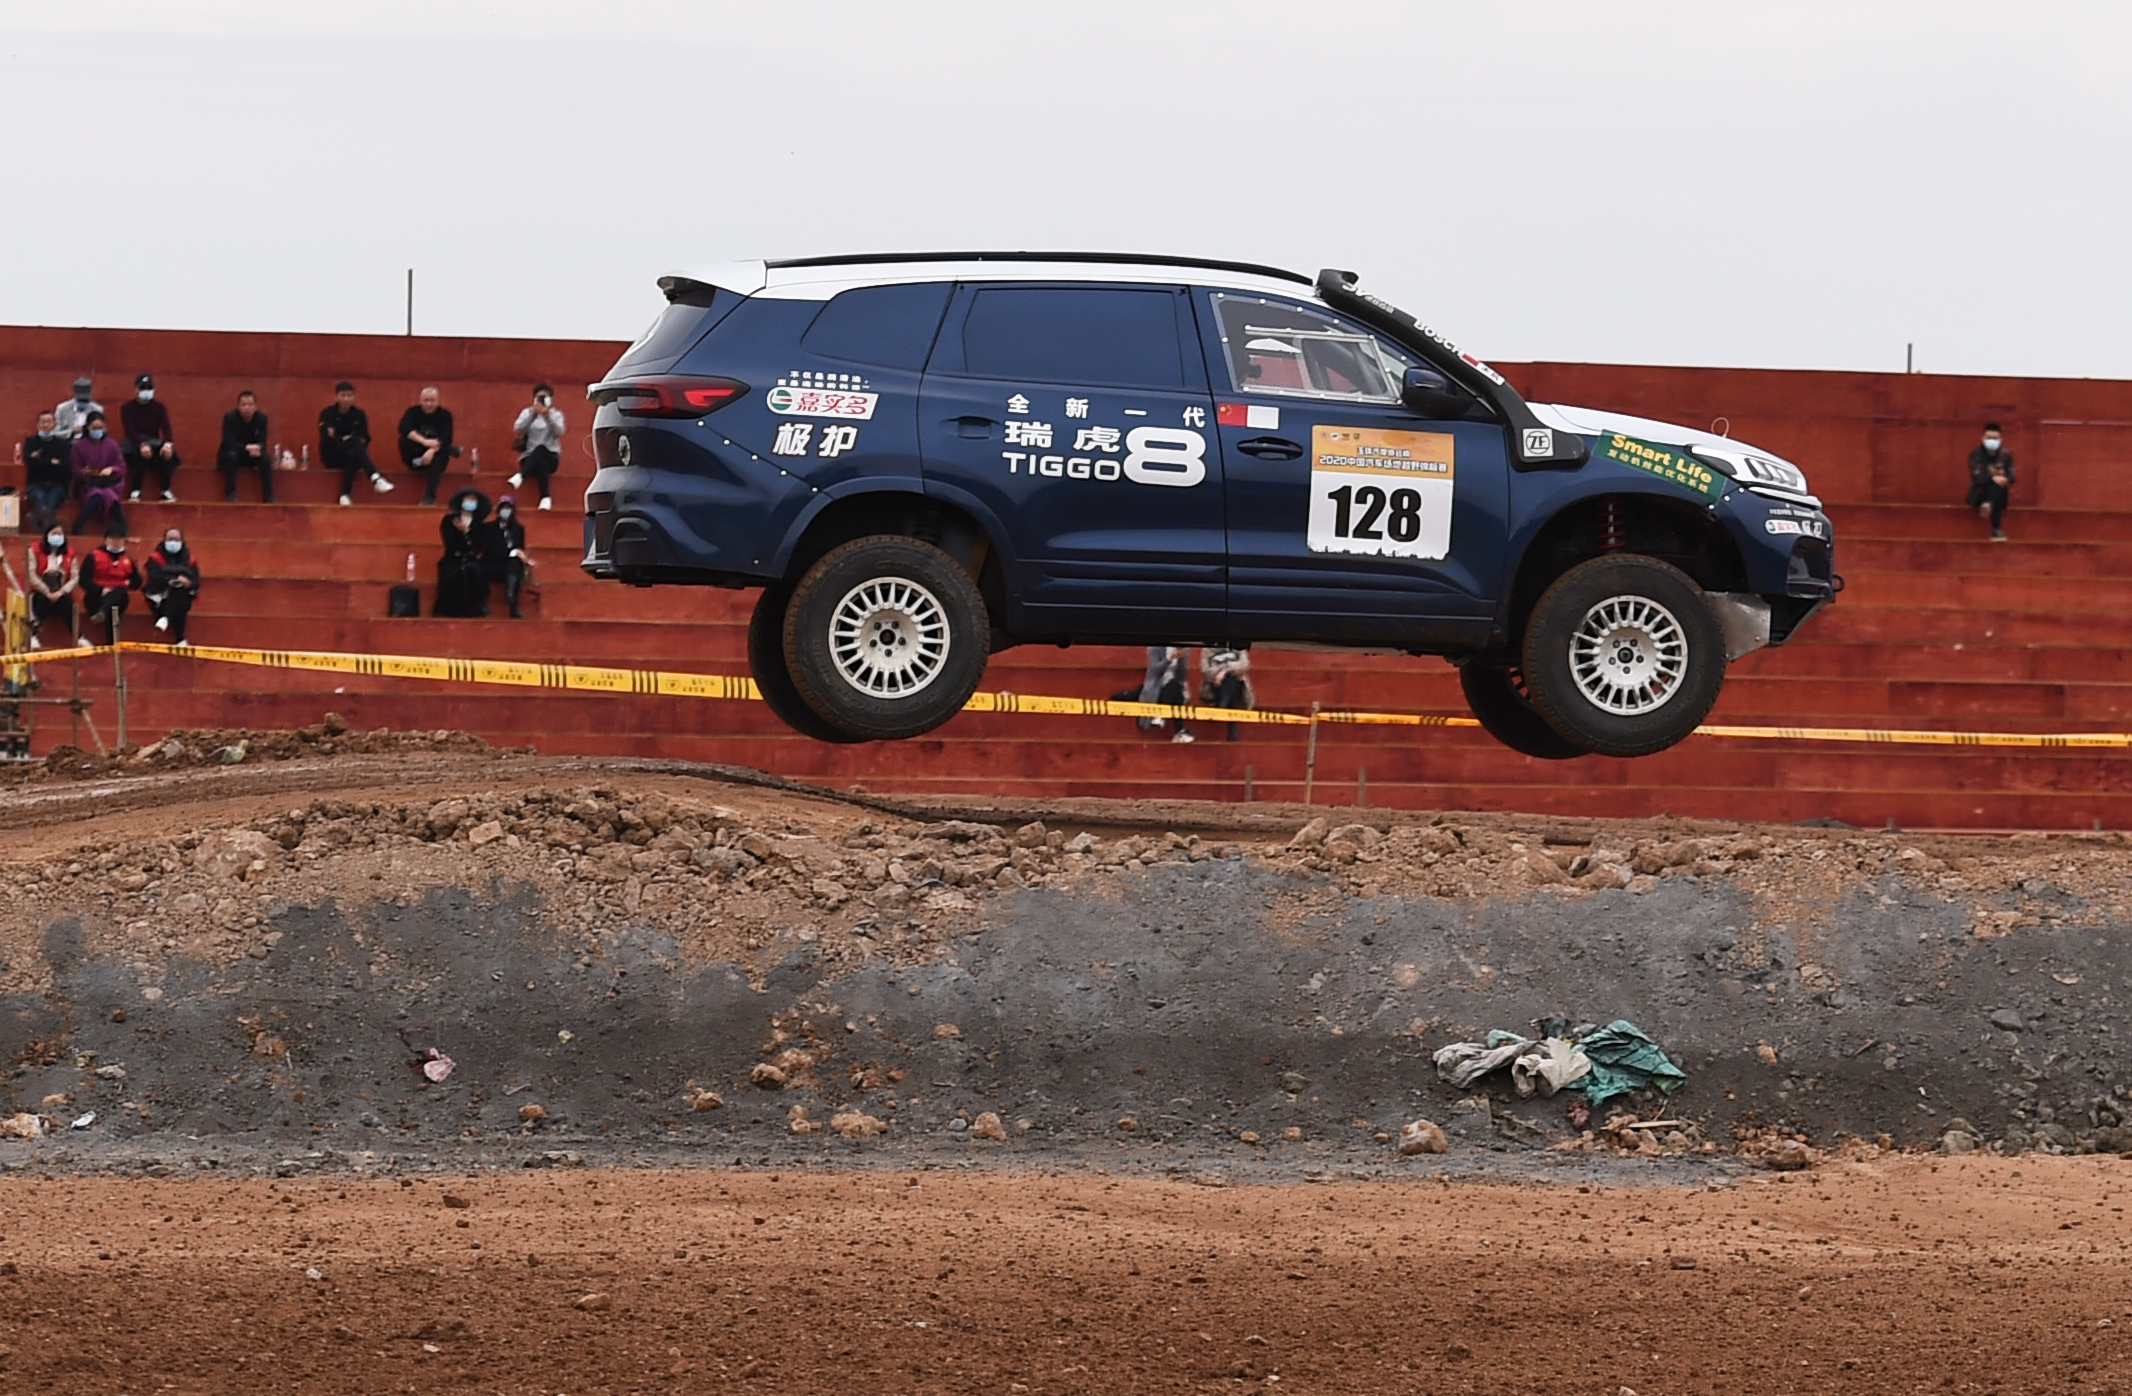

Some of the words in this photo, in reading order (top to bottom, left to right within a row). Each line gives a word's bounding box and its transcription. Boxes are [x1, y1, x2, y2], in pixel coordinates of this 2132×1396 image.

[796, 392, 869, 415] 嘉实多
[1007, 394, 1206, 428] 全新一代
[771, 422, 859, 458] 极护
[1003, 420, 1122, 453] 瑞虎
[1001, 451, 1121, 482] TIGGO
[1123, 426, 1206, 487] 8
[1611, 433, 1672, 466] Smart
[1675, 457, 1713, 484] Life
[1327, 485, 1422, 543] 128
